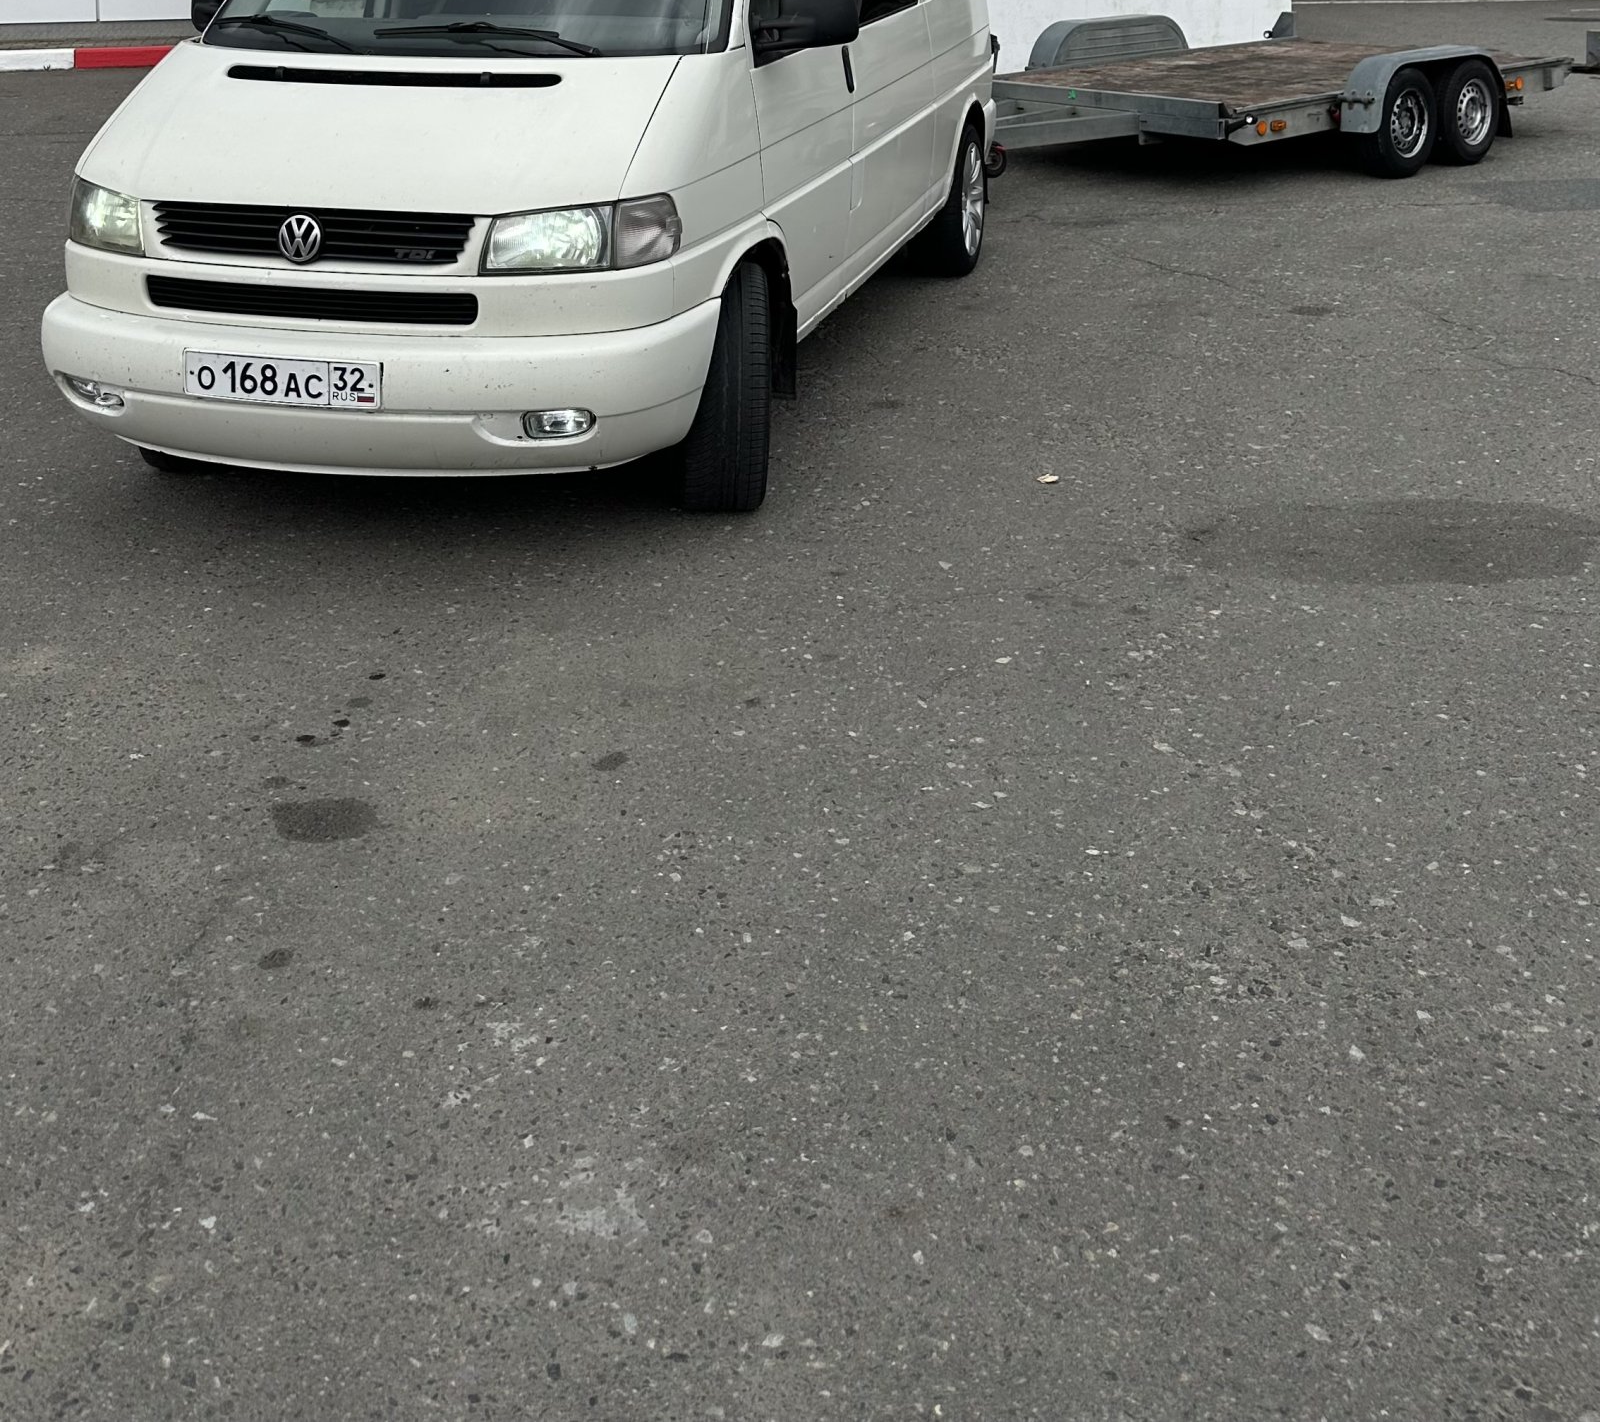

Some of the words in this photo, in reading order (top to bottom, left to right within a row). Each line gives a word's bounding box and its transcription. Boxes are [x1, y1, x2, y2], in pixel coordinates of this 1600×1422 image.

[394, 249, 436, 260] TDI
[333, 366, 365, 393] 32
[332, 391, 357, 403] RUS
